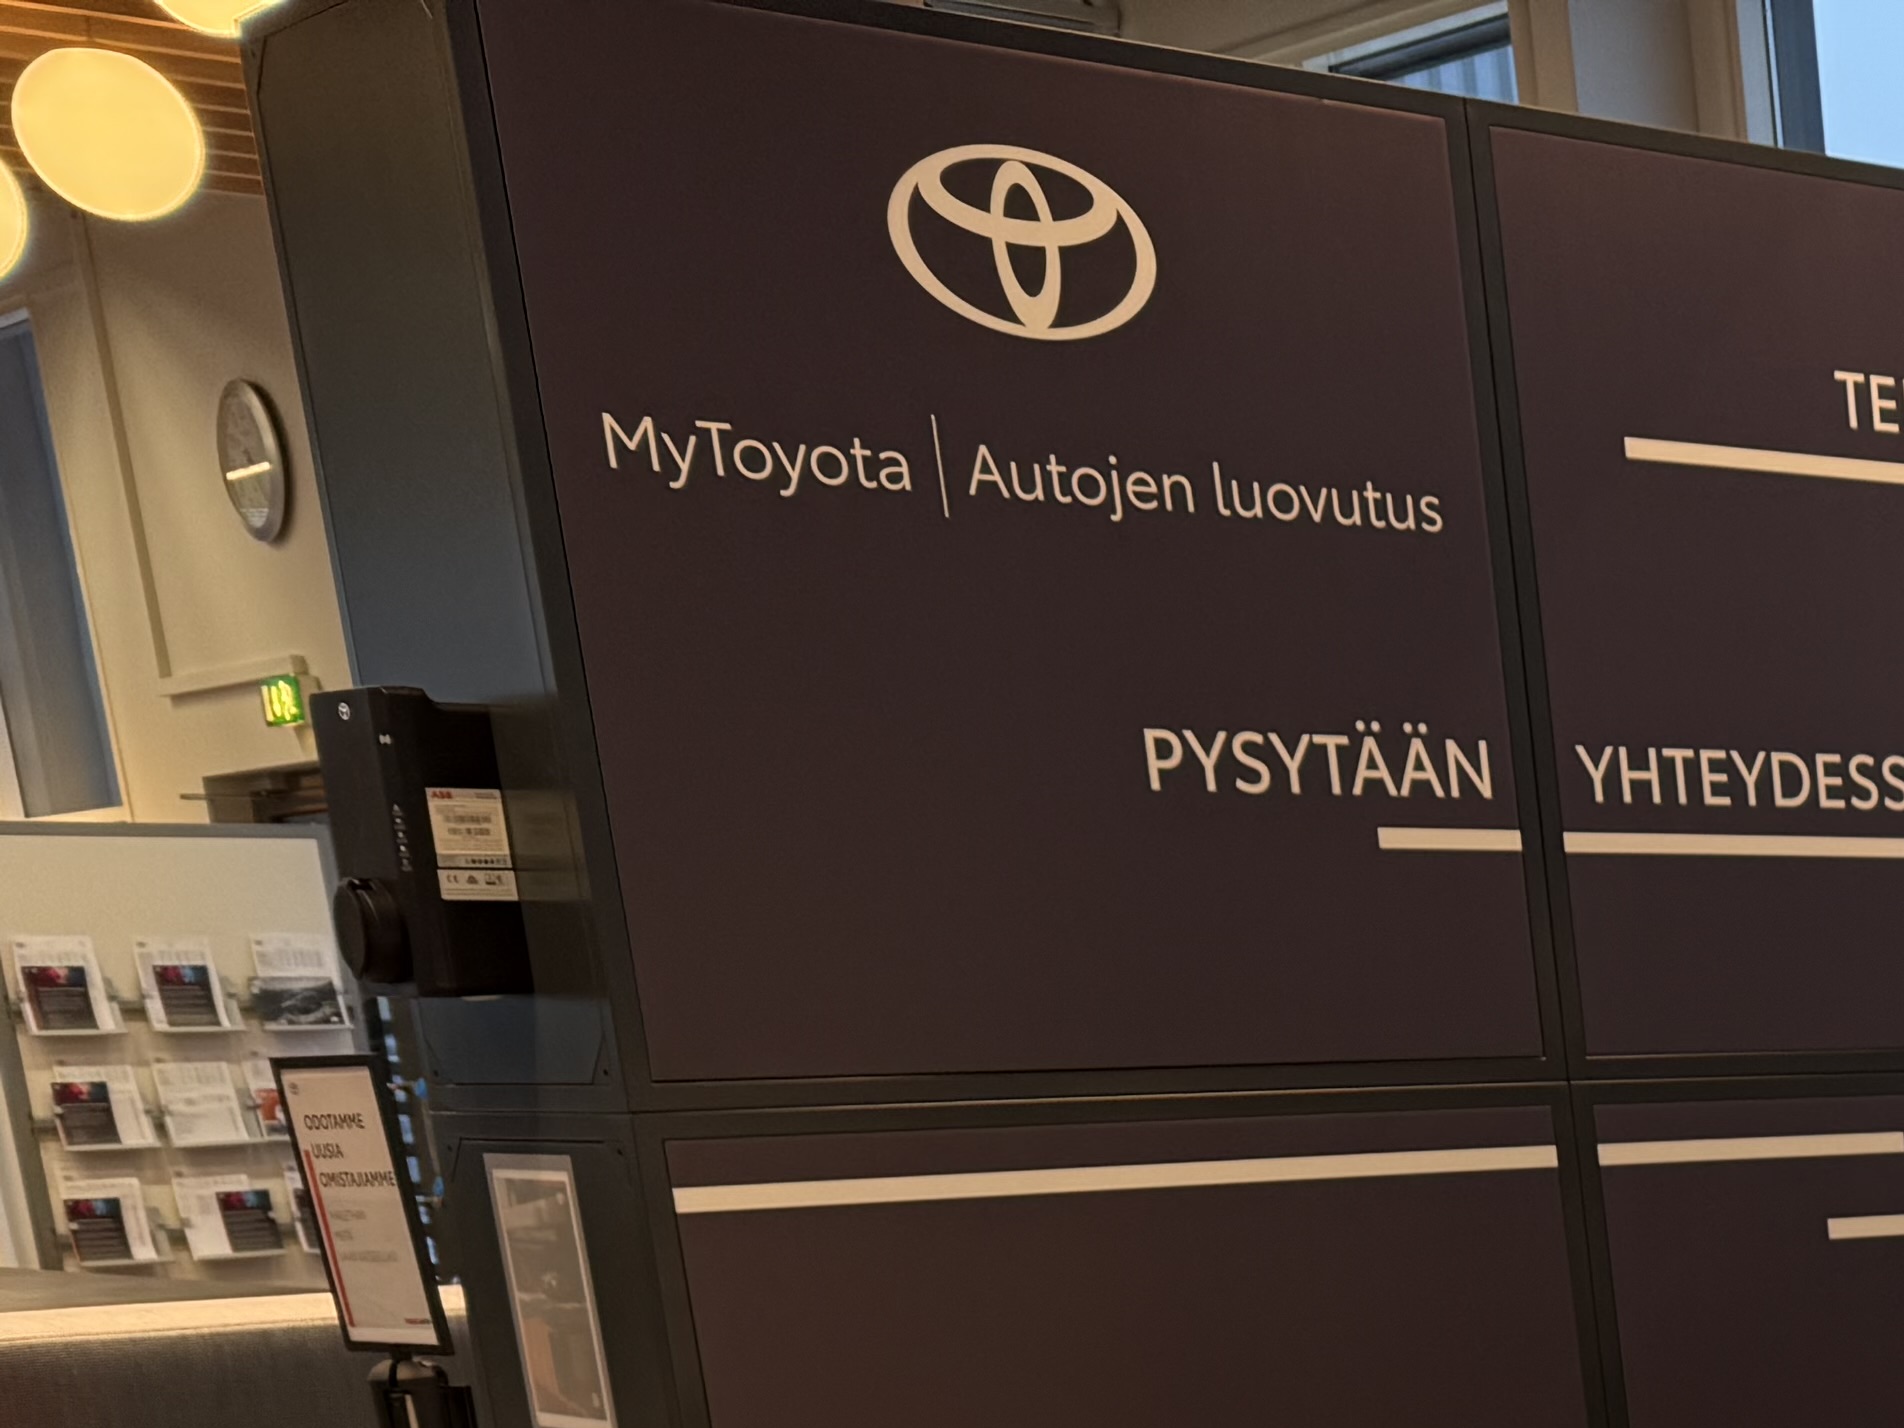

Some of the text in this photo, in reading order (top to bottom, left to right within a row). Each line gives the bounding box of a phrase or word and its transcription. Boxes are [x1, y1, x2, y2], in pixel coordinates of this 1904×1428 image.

[601, 412, 1443, 533] MyToyota Autojen luovutus
[1143, 719, 1493, 800] PYSYTÄÄN
[304, 1113, 366, 1131] ODOTAMME
[311, 1143, 344, 1159] UUSIA
[319, 1170, 396, 1188] OMISTAJIAMME
